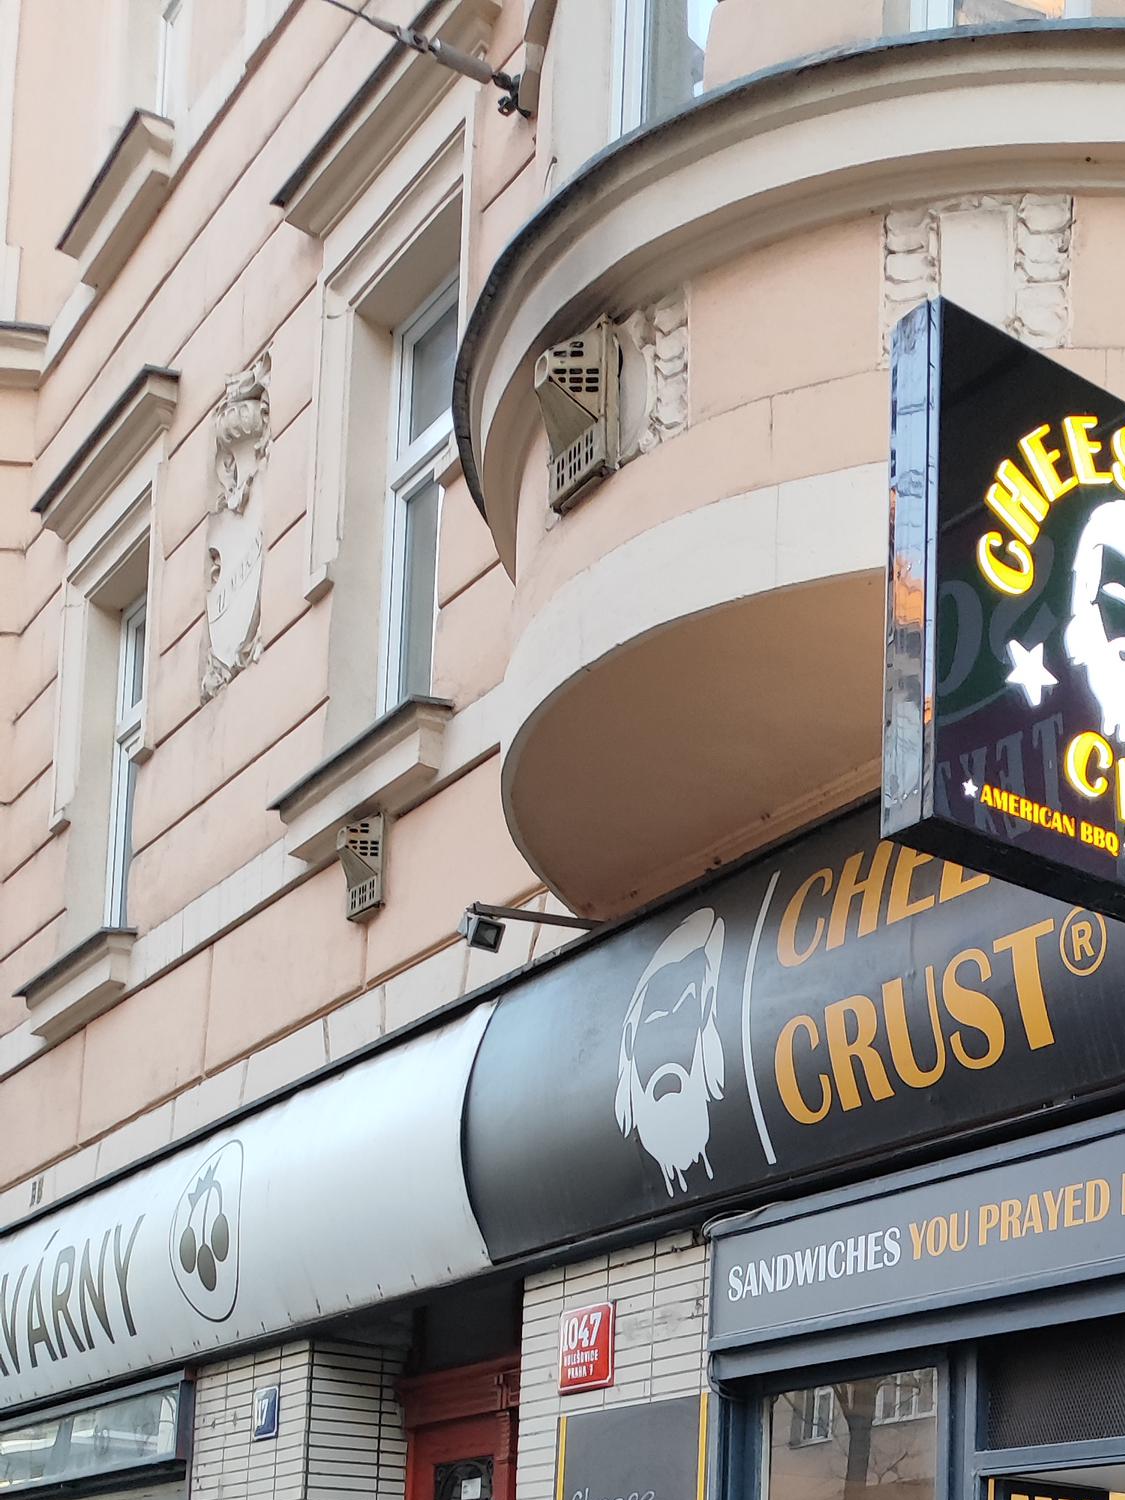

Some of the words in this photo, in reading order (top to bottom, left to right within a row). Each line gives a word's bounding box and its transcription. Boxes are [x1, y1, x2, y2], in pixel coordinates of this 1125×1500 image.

[979, 783, 1075, 837] AMERICAN
[1079, 819, 1121, 857] BBQ
[726, 1226, 902, 1302] SANDWICHES
[908, 1209, 969, 1261] YOU
[977, 1178, 1110, 1248] PRAYED
[0, 1214, 146, 1377] VÁRNY
[562, 1312, 602, 1353] 1047
